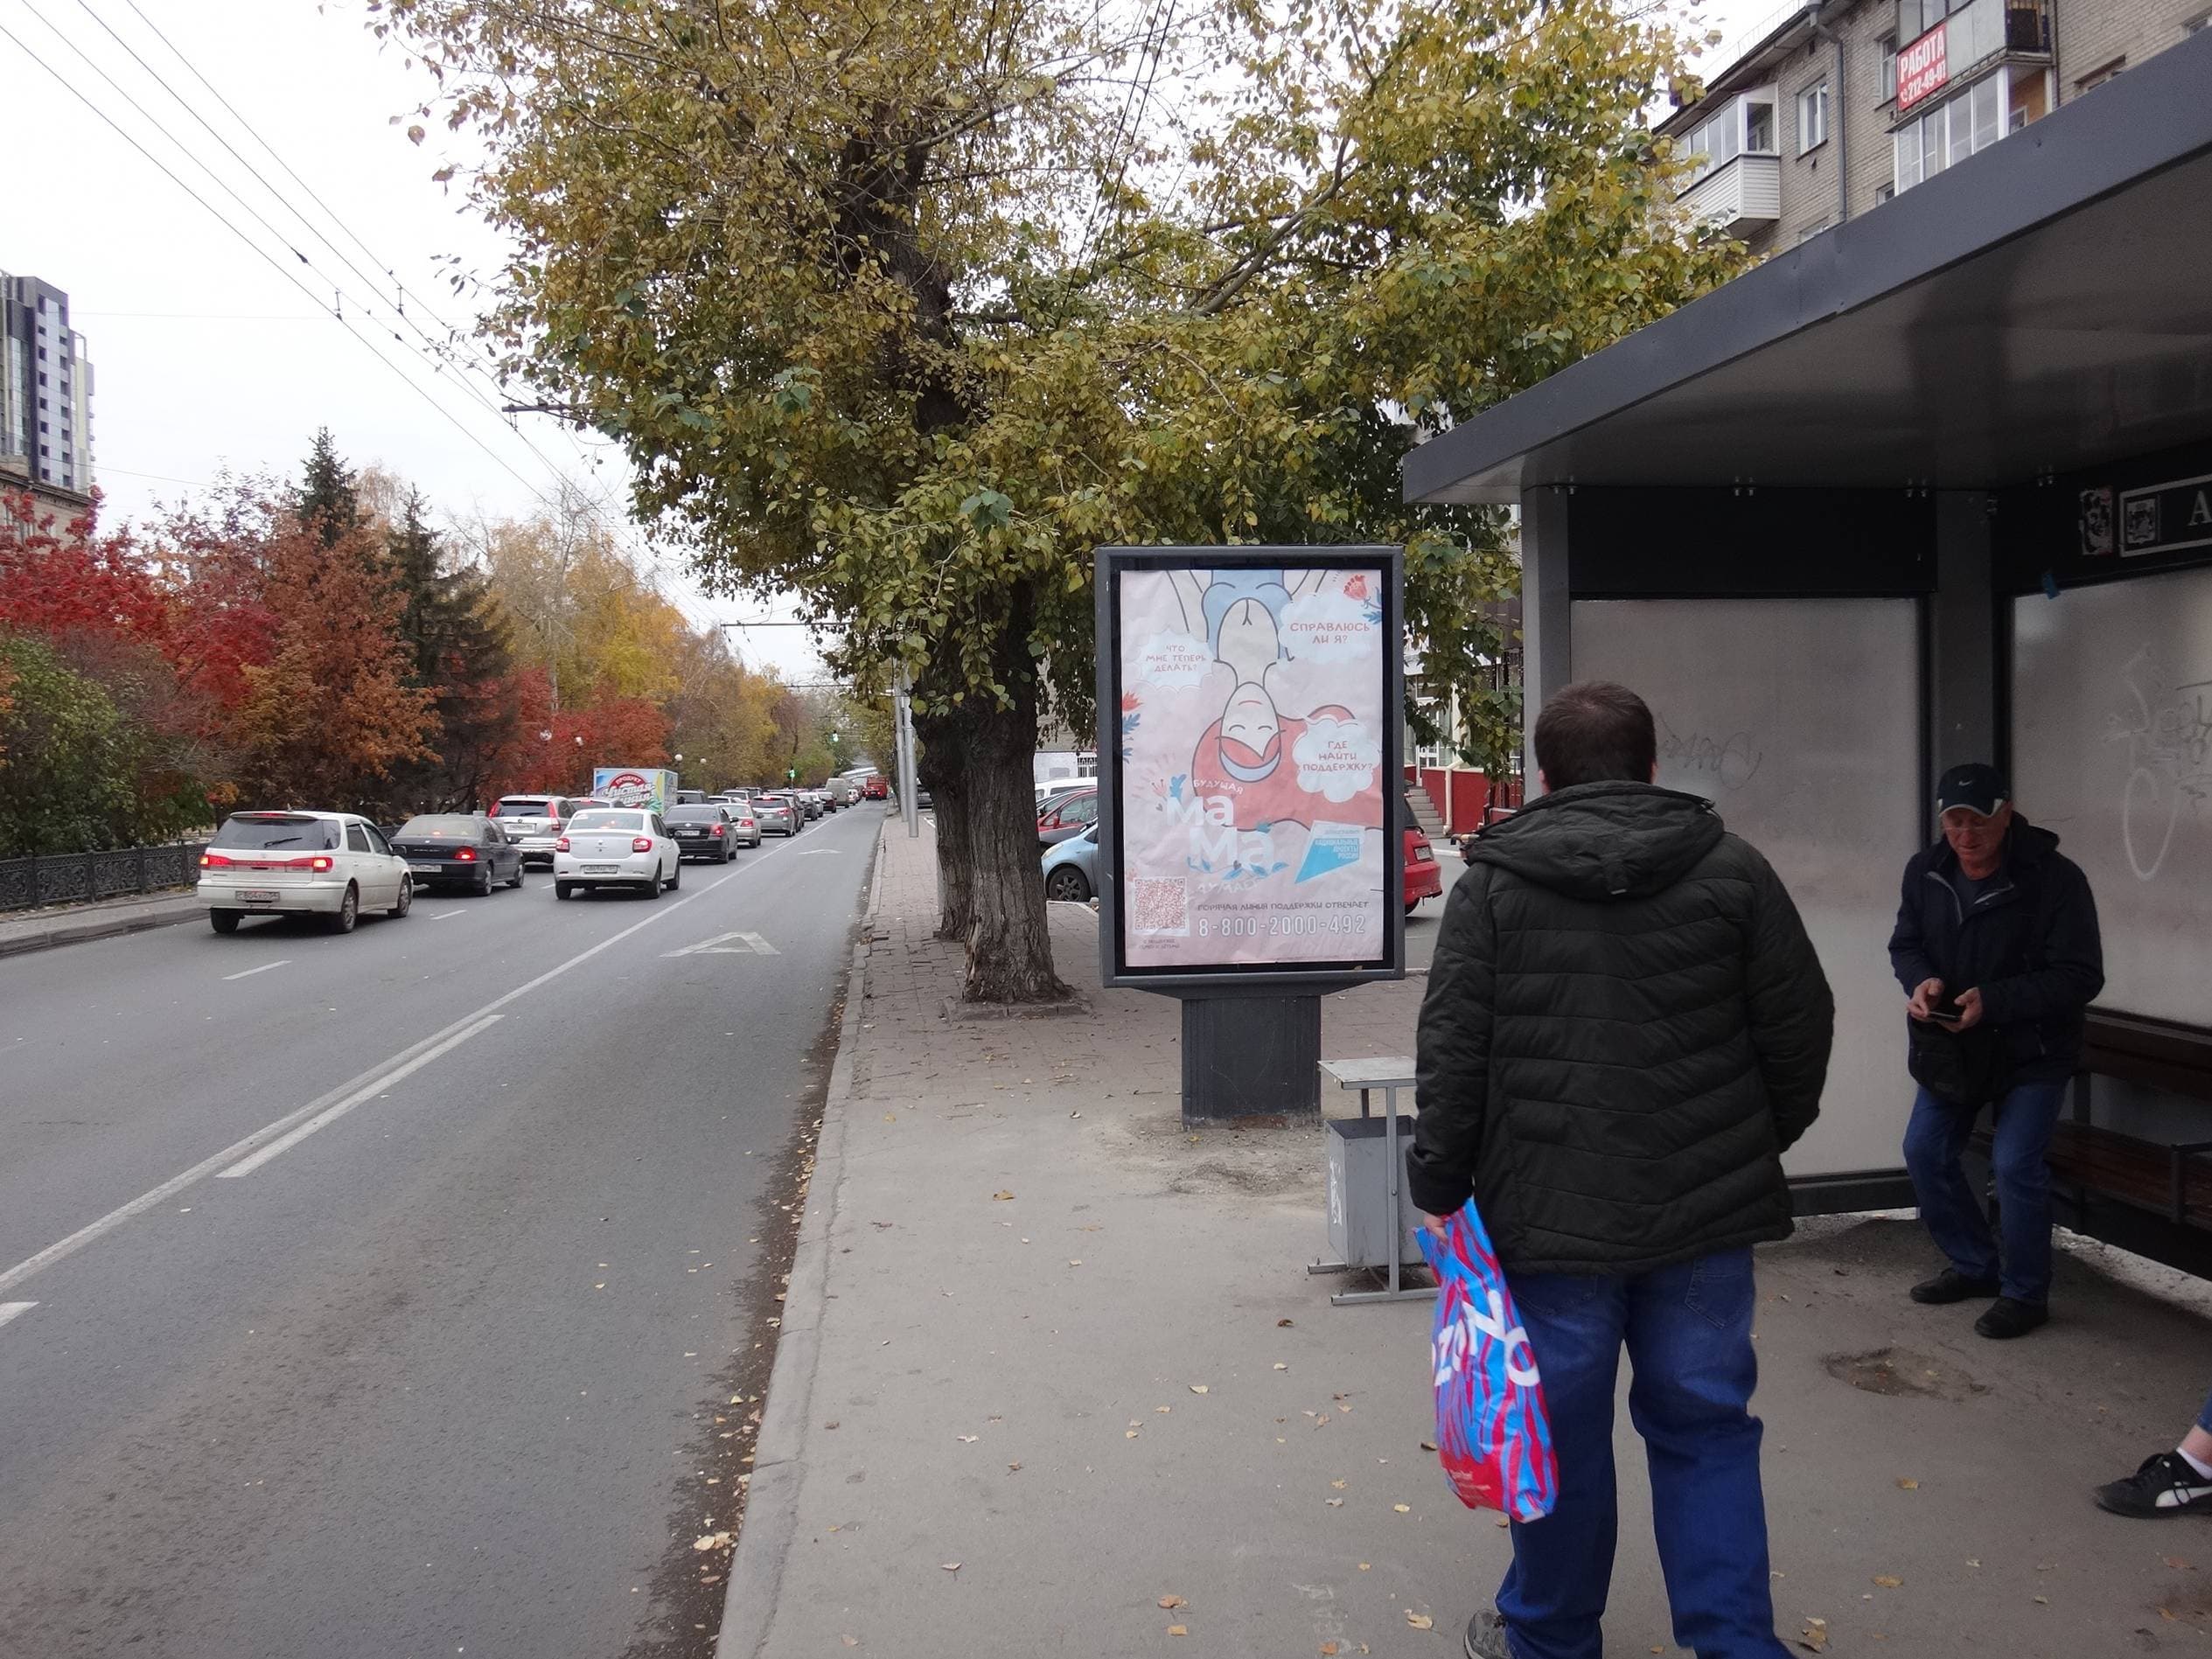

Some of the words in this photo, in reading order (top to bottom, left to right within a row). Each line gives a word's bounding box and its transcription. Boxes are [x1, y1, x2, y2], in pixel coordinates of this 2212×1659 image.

[1900, 30, 1945, 83] РАБОТА
[1289, 622, 1370, 631] СПРАВЛЮСЬ
[1312, 635, 1329, 644] ЛИ
[1334, 635, 1348, 644] Я?
[1155, 664, 1197, 673] ДЕЛАТЬ?
[1328, 741, 1348, 749] ГДЕ
[1302, 763, 1373, 772] ПОДДЕРЖКУ?
[1271, 902, 1322, 910] ПОДДЕРЖКИ
[1198, 915, 1365, 938] 8-800-2000-492
